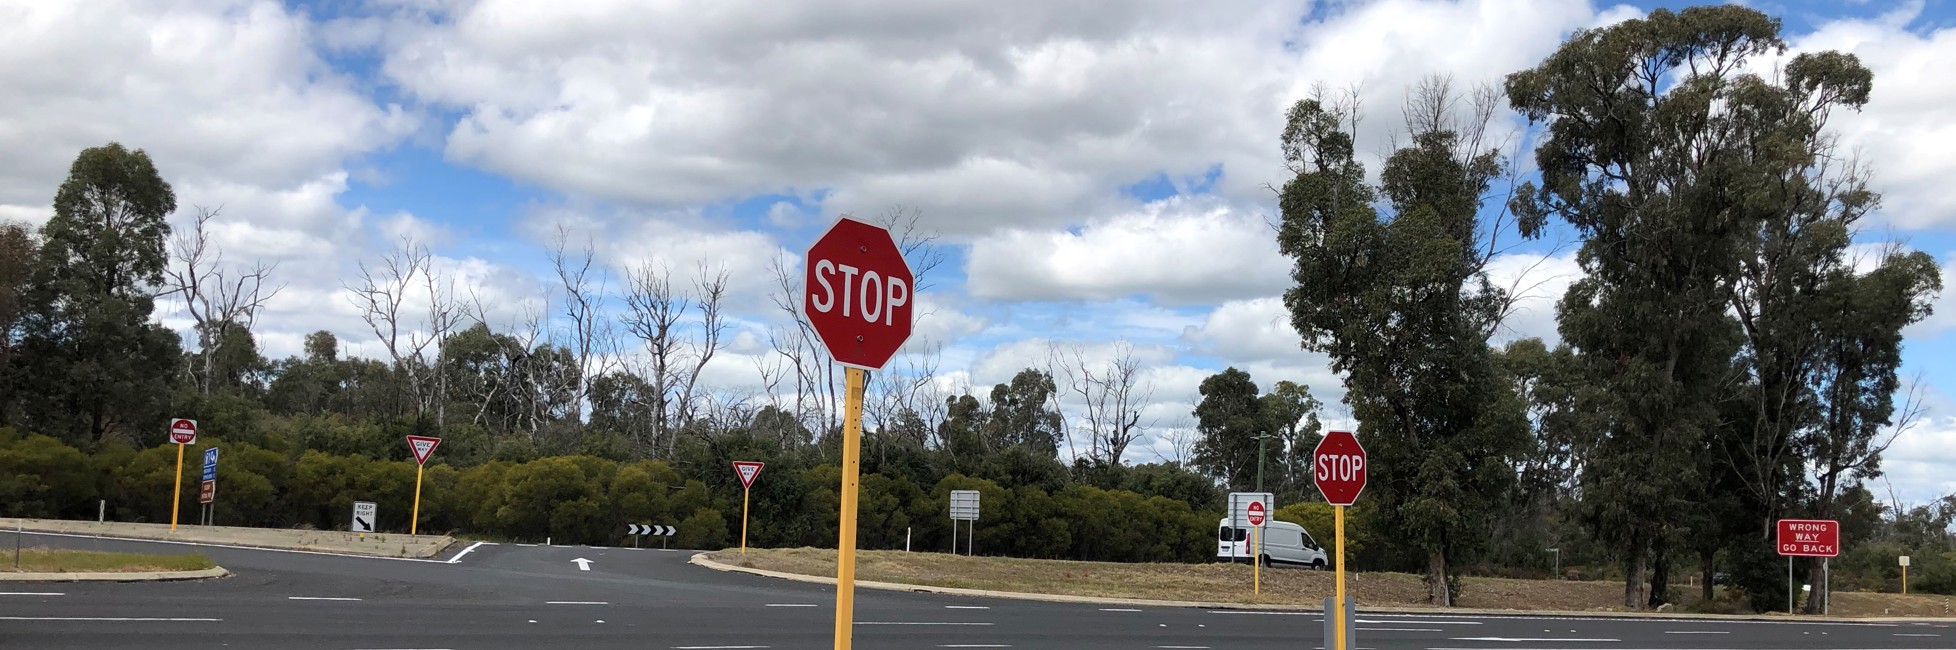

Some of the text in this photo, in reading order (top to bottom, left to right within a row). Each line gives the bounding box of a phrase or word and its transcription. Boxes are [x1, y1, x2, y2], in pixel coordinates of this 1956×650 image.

[812, 259, 908, 326] STOP
[1318, 453, 1363, 481] STOP
[1789, 523, 1827, 531] WRONG
[1795, 533, 1819, 541] WAY
[1783, 544, 1833, 553] GO BACK
